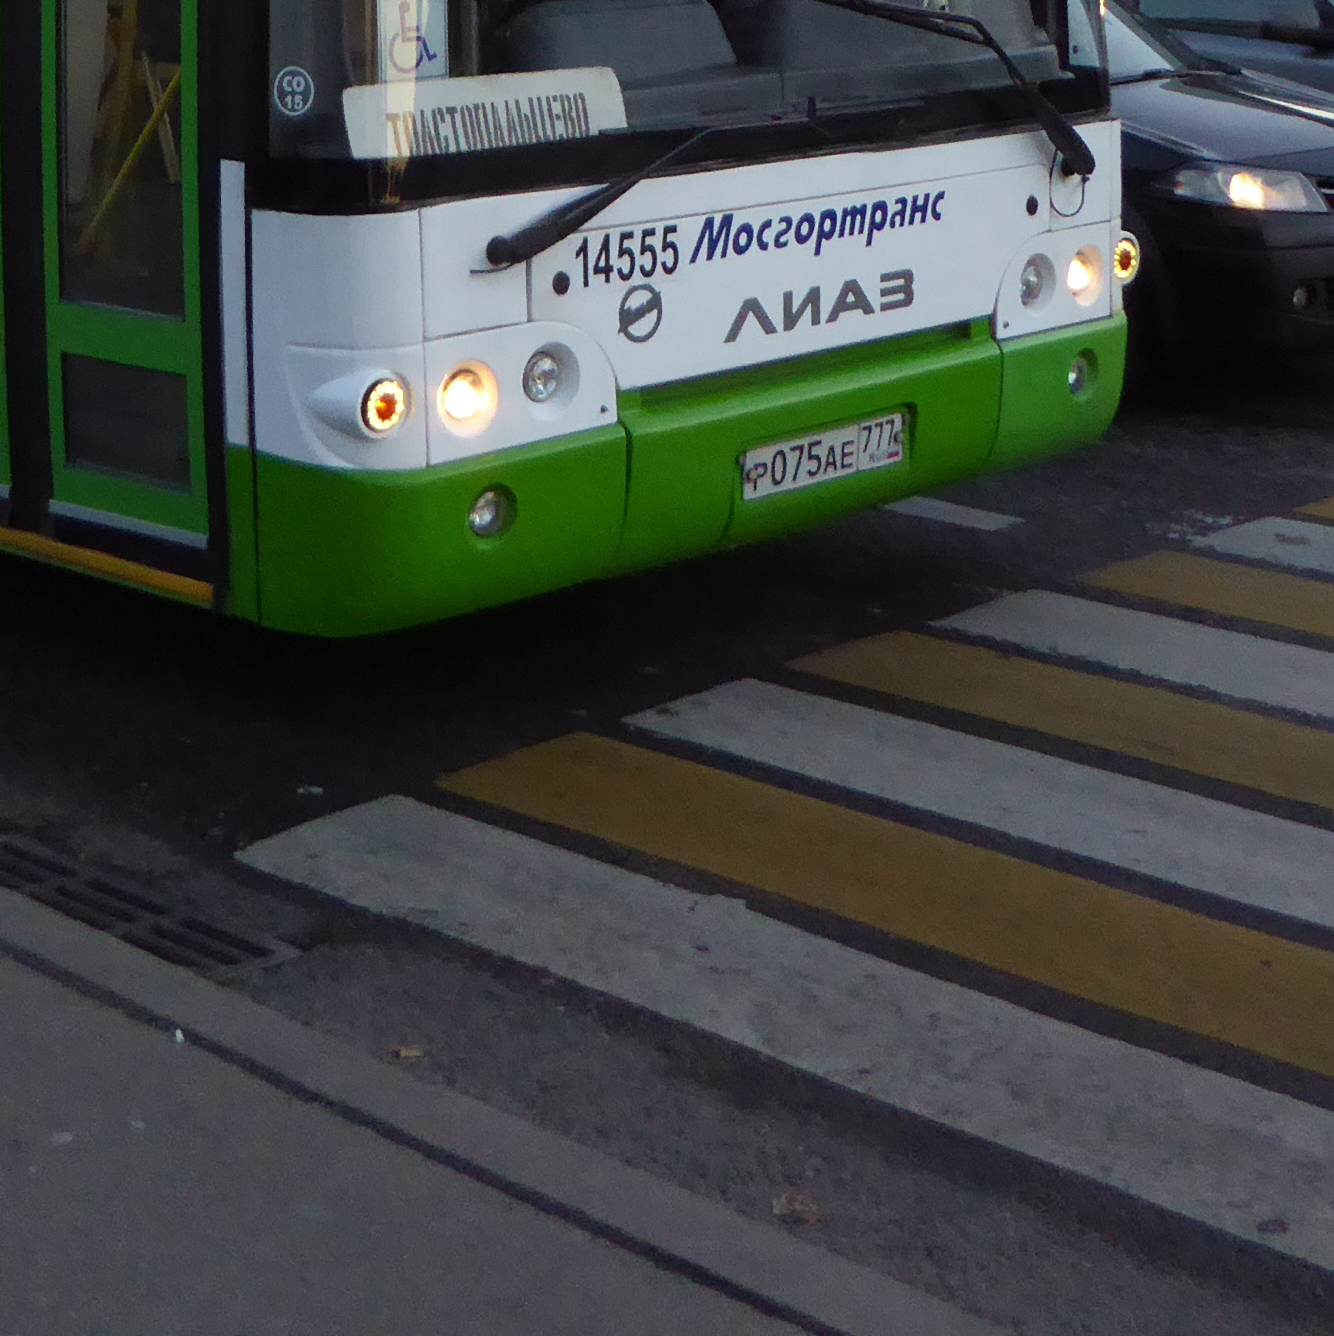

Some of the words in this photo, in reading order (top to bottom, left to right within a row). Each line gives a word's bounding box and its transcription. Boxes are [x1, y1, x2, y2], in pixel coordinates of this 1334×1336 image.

[576, 225, 679, 288] 14555
[689, 190, 945, 264] Мосгортранс
[724, 269, 915, 343] ЛИАЗ
